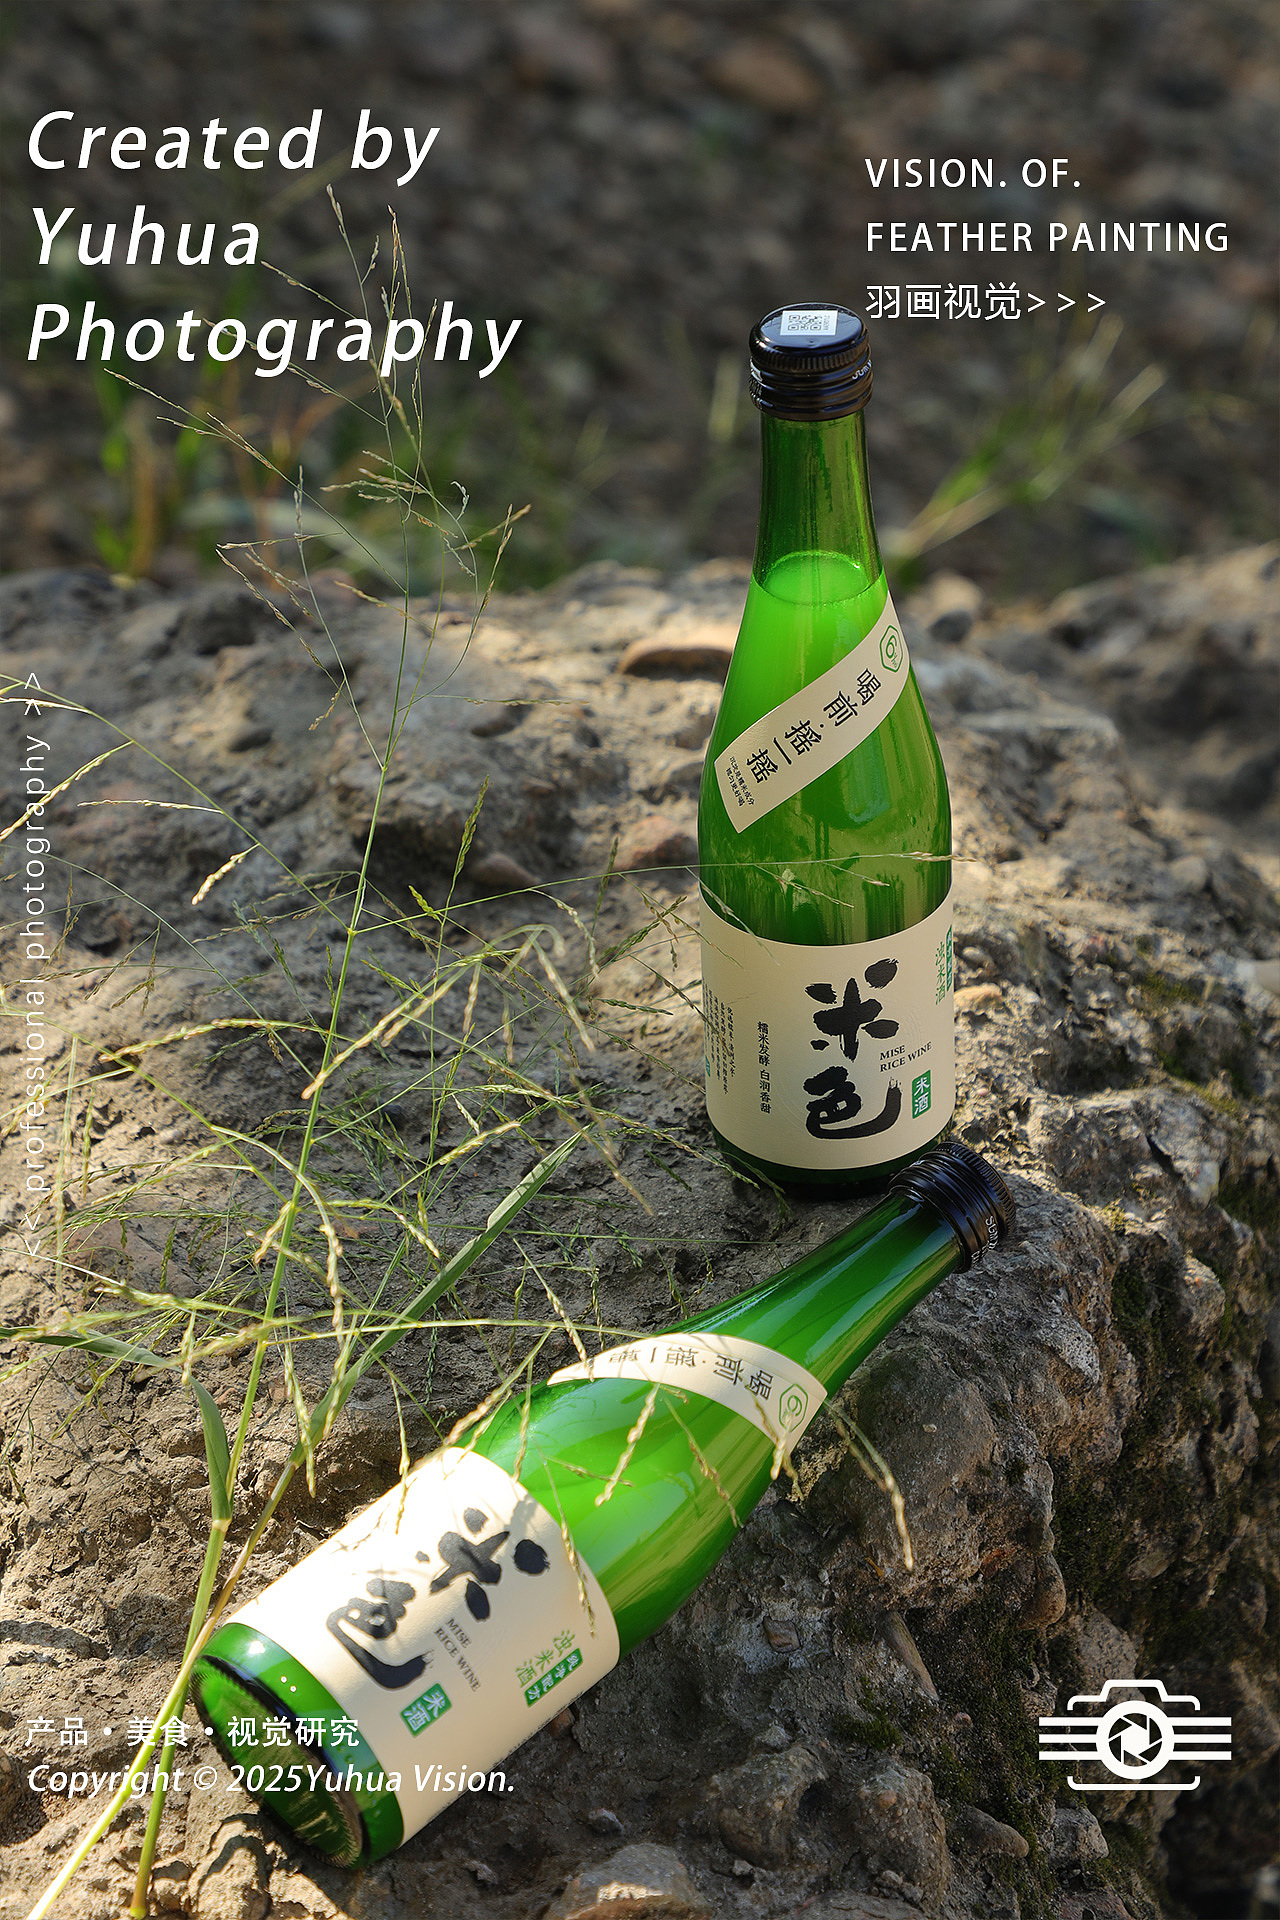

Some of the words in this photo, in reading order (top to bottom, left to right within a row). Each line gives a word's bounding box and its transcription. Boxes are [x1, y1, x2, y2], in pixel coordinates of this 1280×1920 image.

[757, 1021, 770, 1067] 糯米发酵
[880, 1045, 905, 1061] MISE
[880, 1057, 905, 1072] RICE
[907, 1041, 932, 1062] WINE
[914, 1077, 930, 1115] 米酒
[446, 1617, 472, 1649] MISE
[434, 1627, 459, 1658] RICE
[457, 1656, 481, 1692] WINE
[403, 1690, 446, 1732] 米酒
